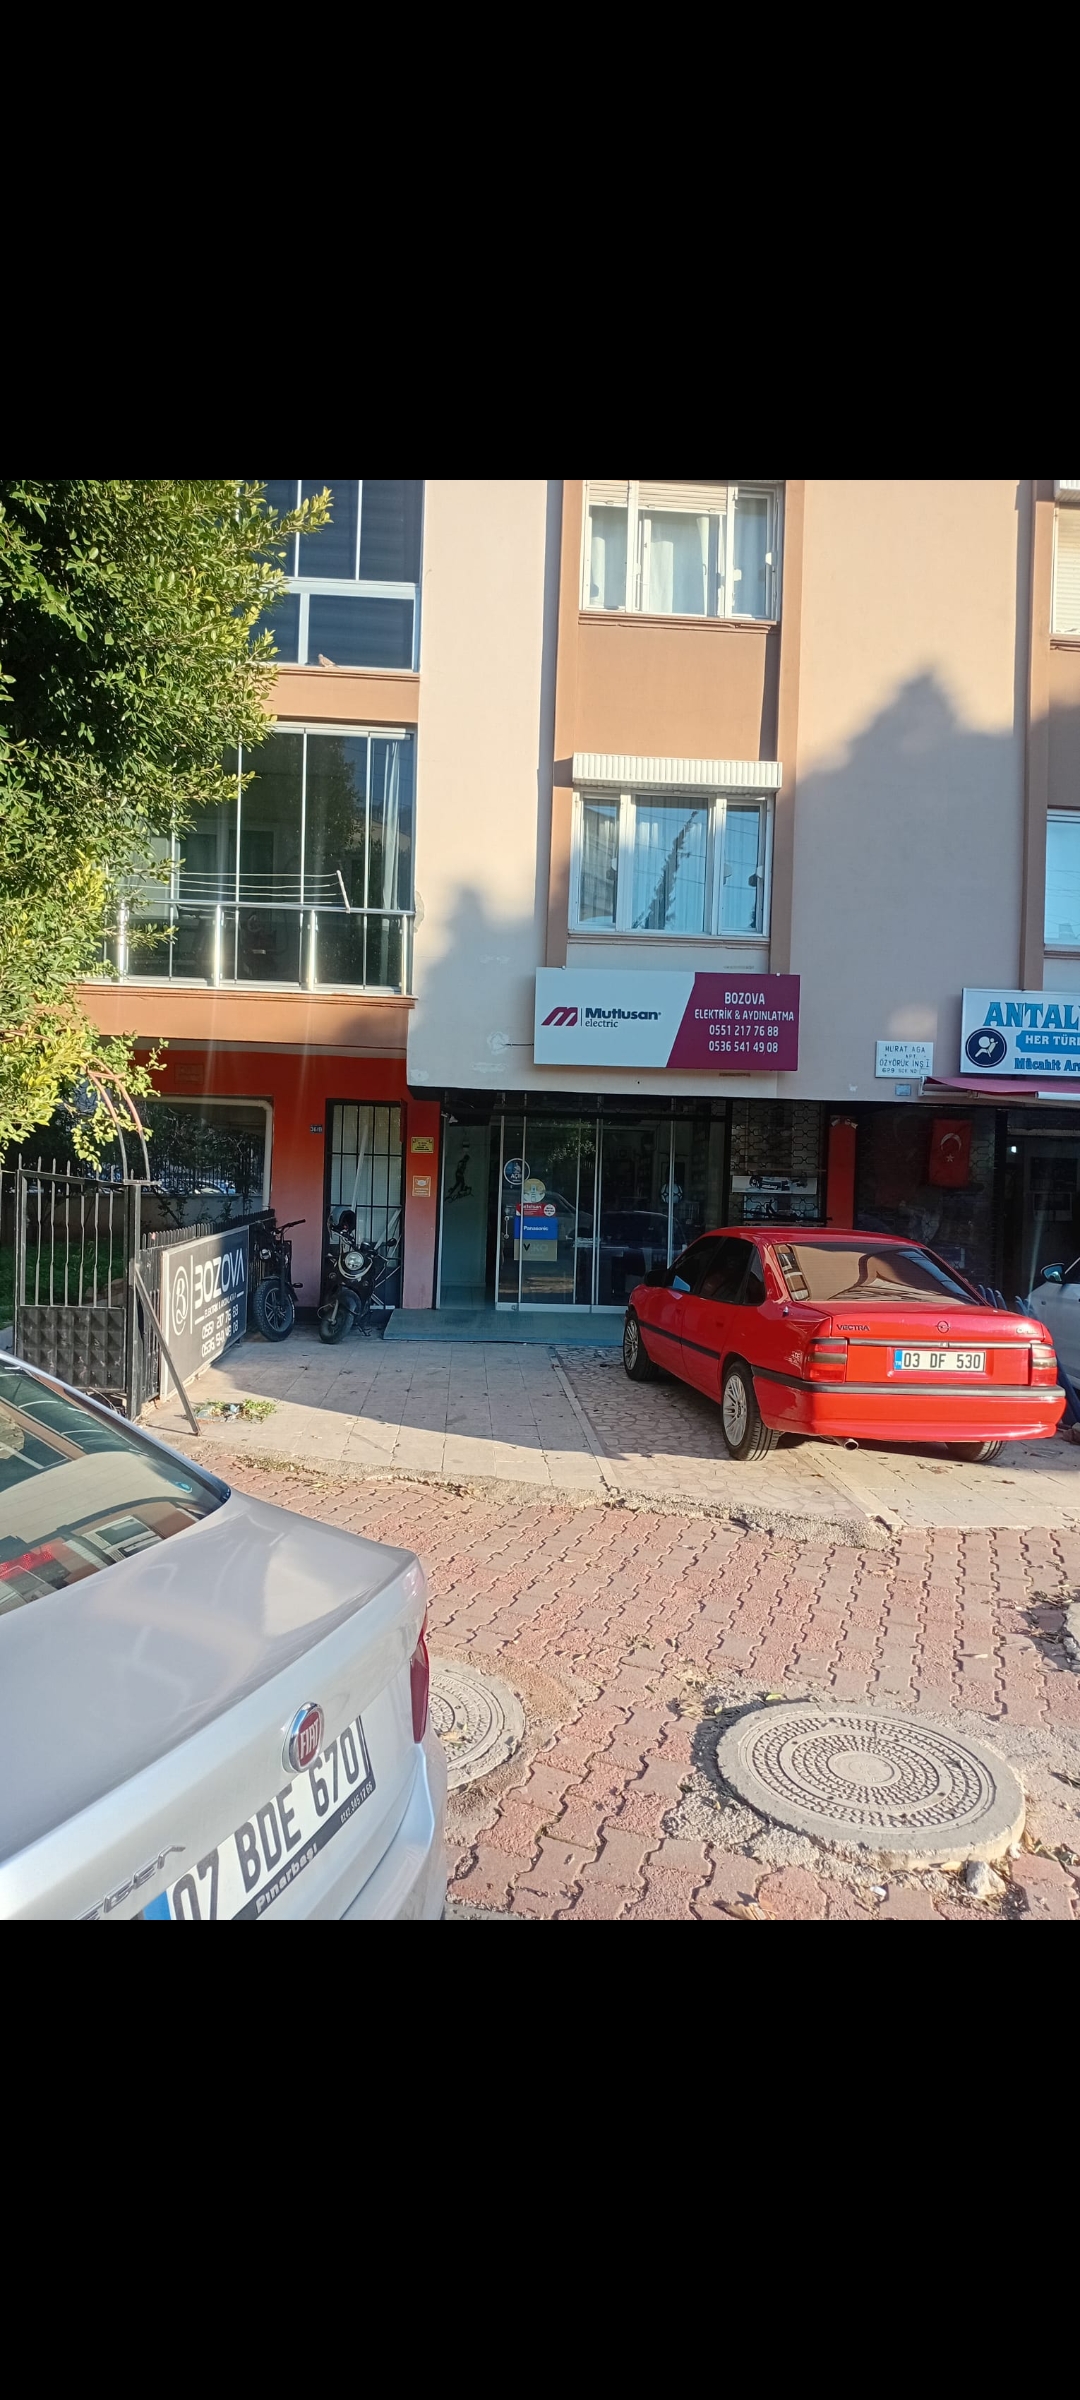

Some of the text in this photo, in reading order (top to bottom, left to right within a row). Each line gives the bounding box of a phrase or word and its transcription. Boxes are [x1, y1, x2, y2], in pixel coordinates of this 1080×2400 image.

[724, 991, 765, 1005] BOZOVA
[585, 1007, 659, 1021] Mutlusan
[694, 1007, 795, 1022] ELEKTRİK & AYDINLATMA
[982, 1001, 1080, 1031] ANTAL
[585, 1018, 619, 1029] electric
[709, 1024, 779, 1037] 0551 217 76 88
[708, 1040, 779, 1053] 0536 541 49 08
[1025, 1034, 1049, 1045] HER
[1014, 1057, 1061, 1071] Mücahit
[194, 1247, 245, 1310] BOZOVA
[836, 1323, 870, 1332] VECTRA
[903, 1352, 981, 1369] 03 DF 530
[300, 1717, 320, 1760] FIAT
[172, 1726, 360, 1920] 07 BDE 670
